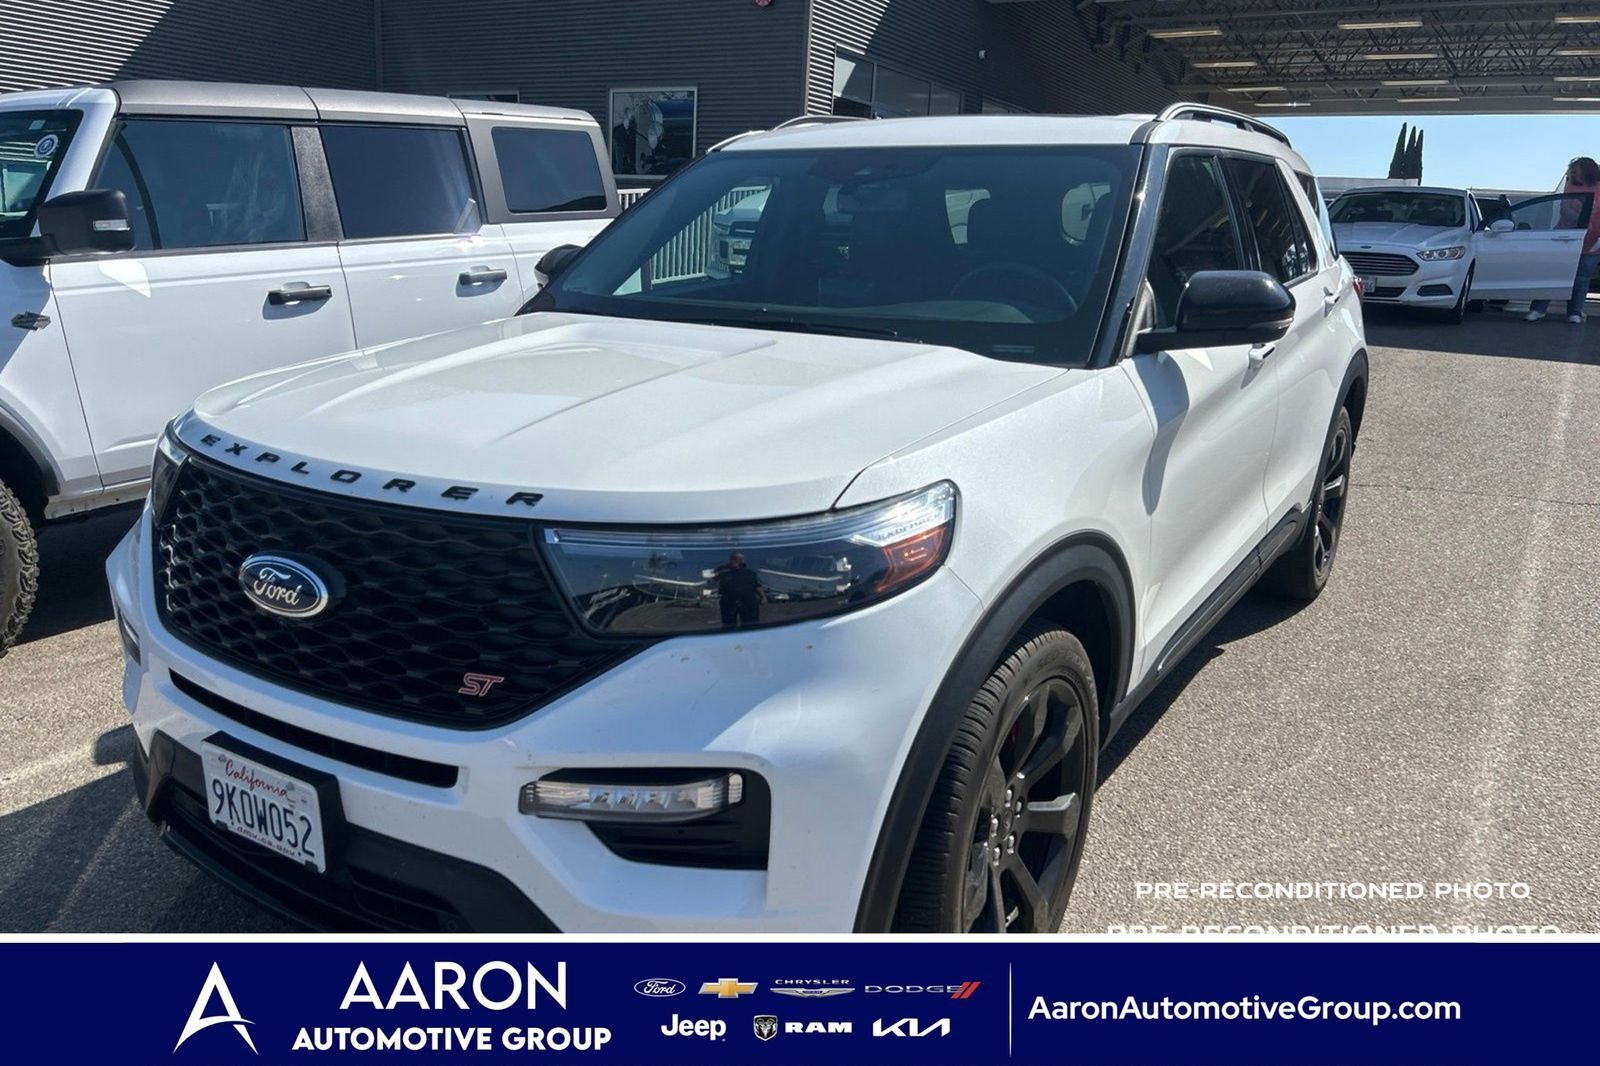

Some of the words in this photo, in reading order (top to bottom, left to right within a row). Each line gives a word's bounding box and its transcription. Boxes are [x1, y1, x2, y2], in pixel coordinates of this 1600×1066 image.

[200, 433, 544, 507] EXPLORER
[253, 567, 302, 605] Ford
[458, 672, 504, 697] ST
[224, 758, 289, 798] California
